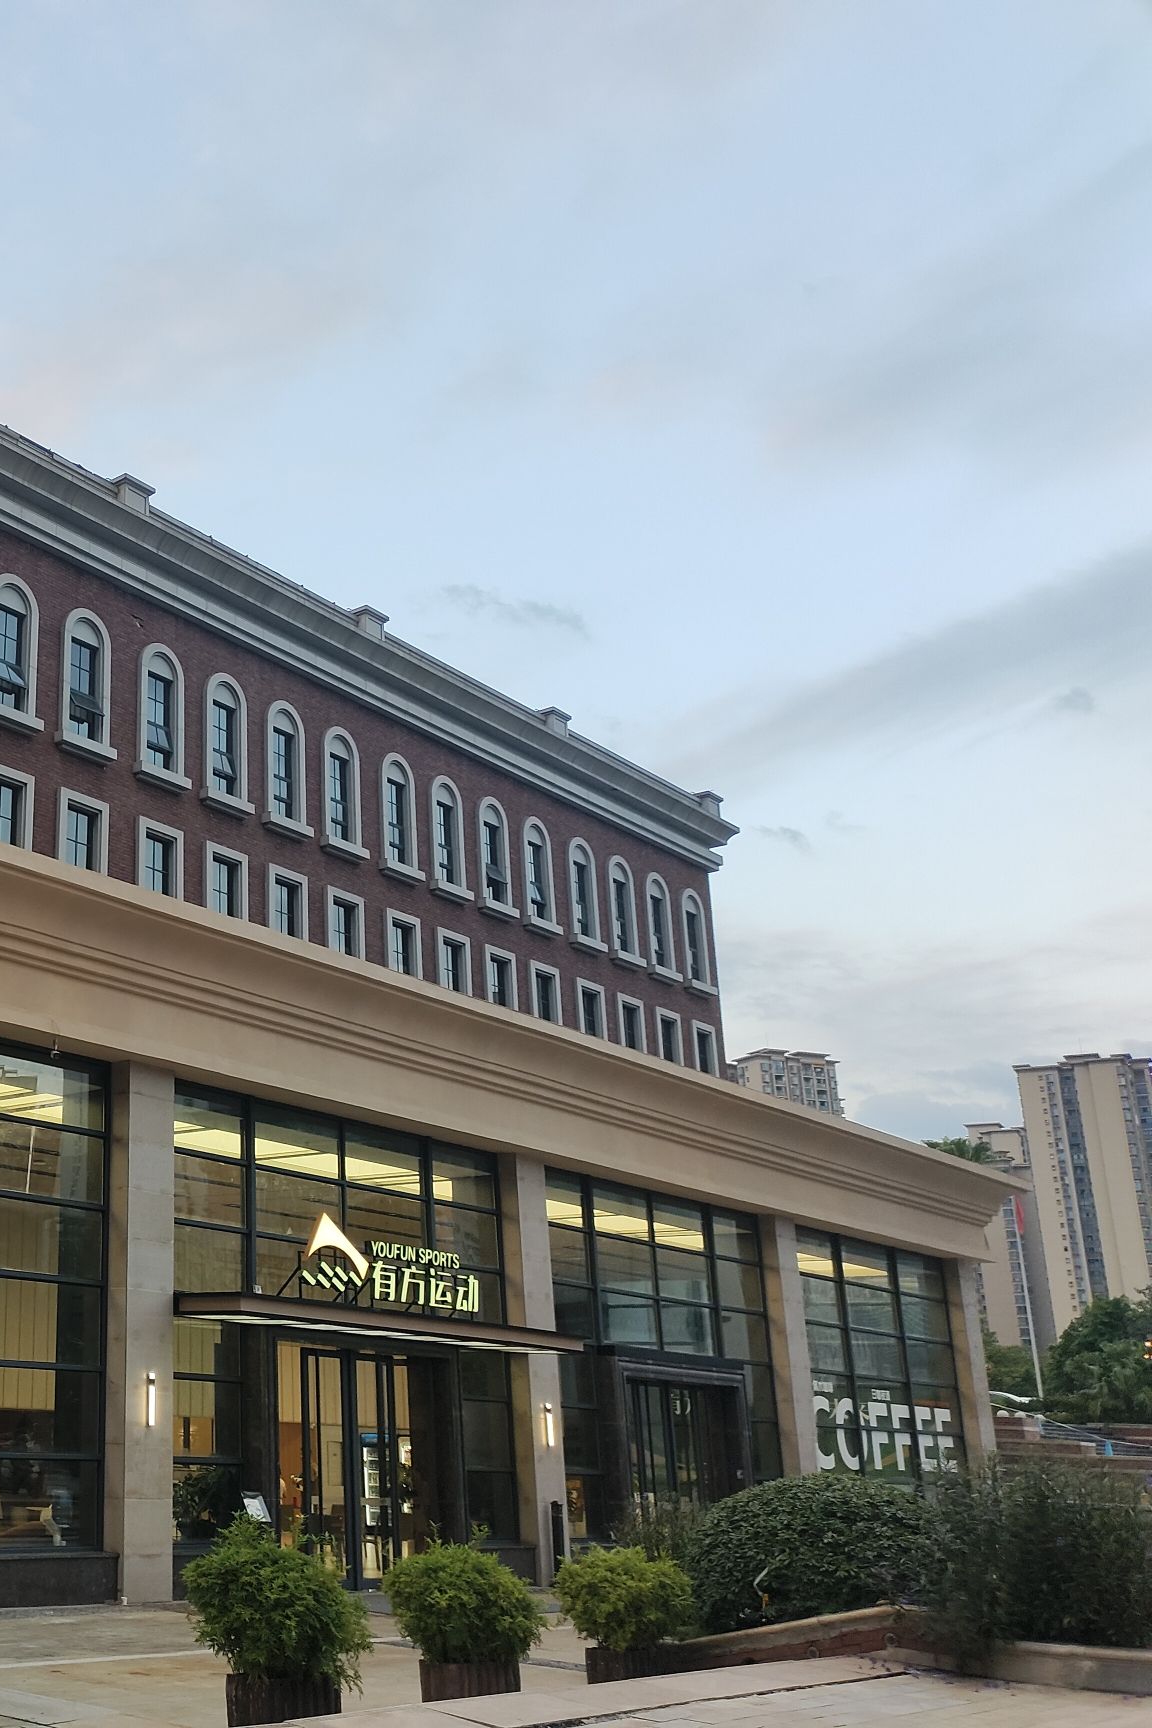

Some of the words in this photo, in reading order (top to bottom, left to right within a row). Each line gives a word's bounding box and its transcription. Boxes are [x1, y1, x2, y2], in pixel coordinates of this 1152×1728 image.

[371, 1240, 416, 1261] YOUFUN
[418, 1247, 460, 1269] SPORTS
[372, 1261, 479, 1313] 有方运动
[813, 1395, 959, 1473] COFFEE
